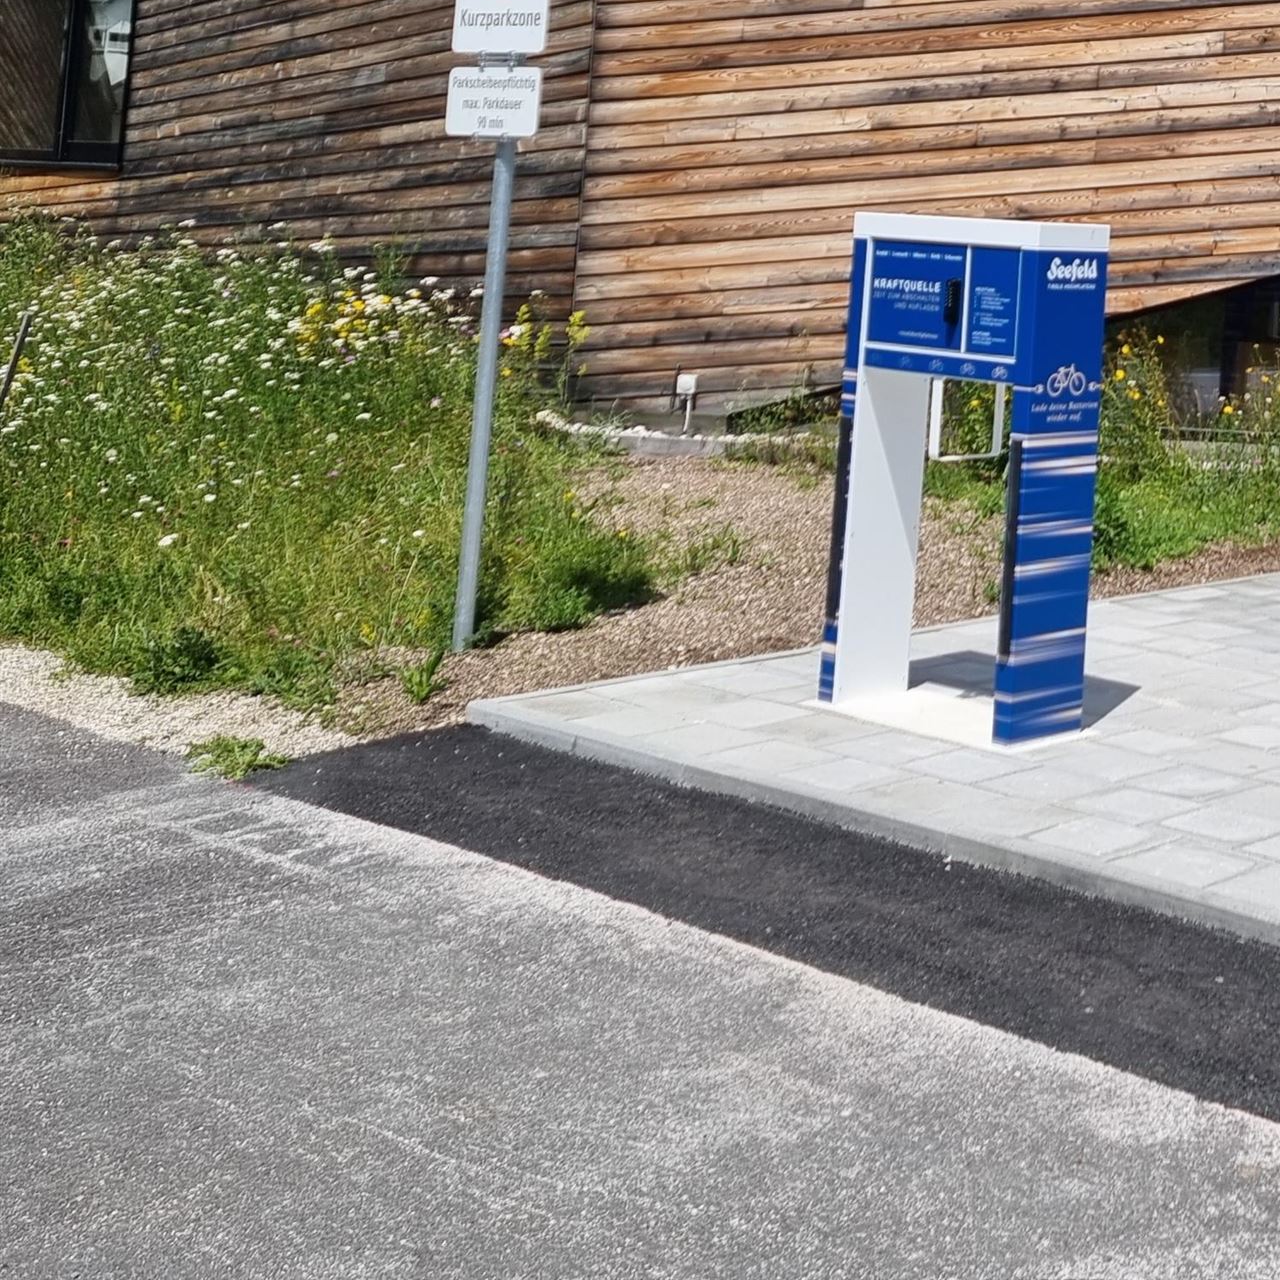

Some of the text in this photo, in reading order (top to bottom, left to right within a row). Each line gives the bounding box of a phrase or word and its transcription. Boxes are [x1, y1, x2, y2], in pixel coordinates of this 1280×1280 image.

[459, 8, 541, 31] Kurzparkzone
[482, 96, 523, 110] Parkdauer
[1047, 256, 1097, 282] Seefeld
[873, 278, 942, 293] KRAFTQUELLE
